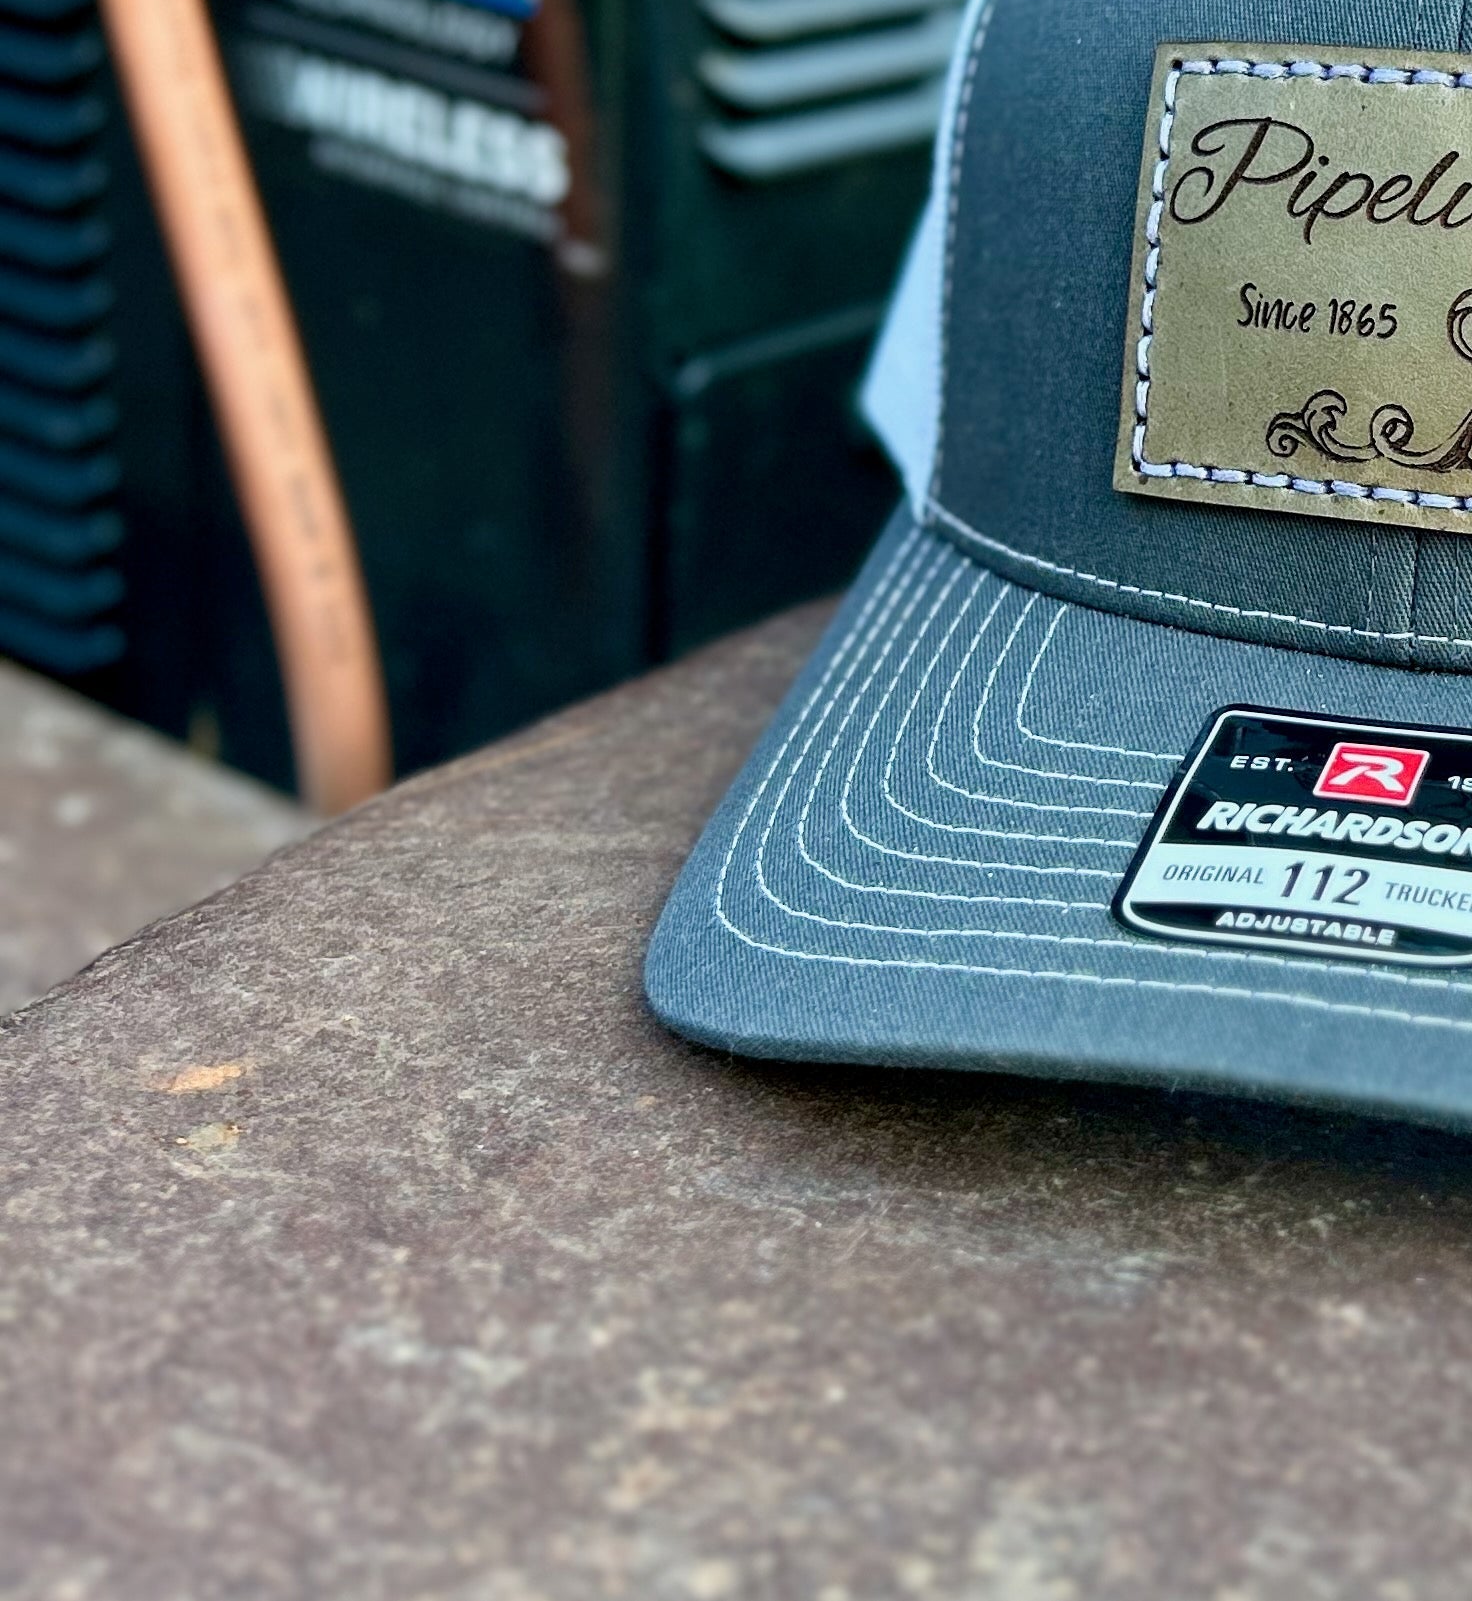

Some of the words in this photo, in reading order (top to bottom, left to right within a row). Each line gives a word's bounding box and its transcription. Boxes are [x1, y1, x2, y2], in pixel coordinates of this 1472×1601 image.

[1236, 282, 1317, 333] Since
[1327, 298, 1398, 340] 1865
[1229, 753, 1295, 773] EST.
[1162, 863, 1265, 886] ORIGINAL
[1279, 859, 1371, 907] 112
[1215, 910, 1396, 947] ADJUSTABLE
